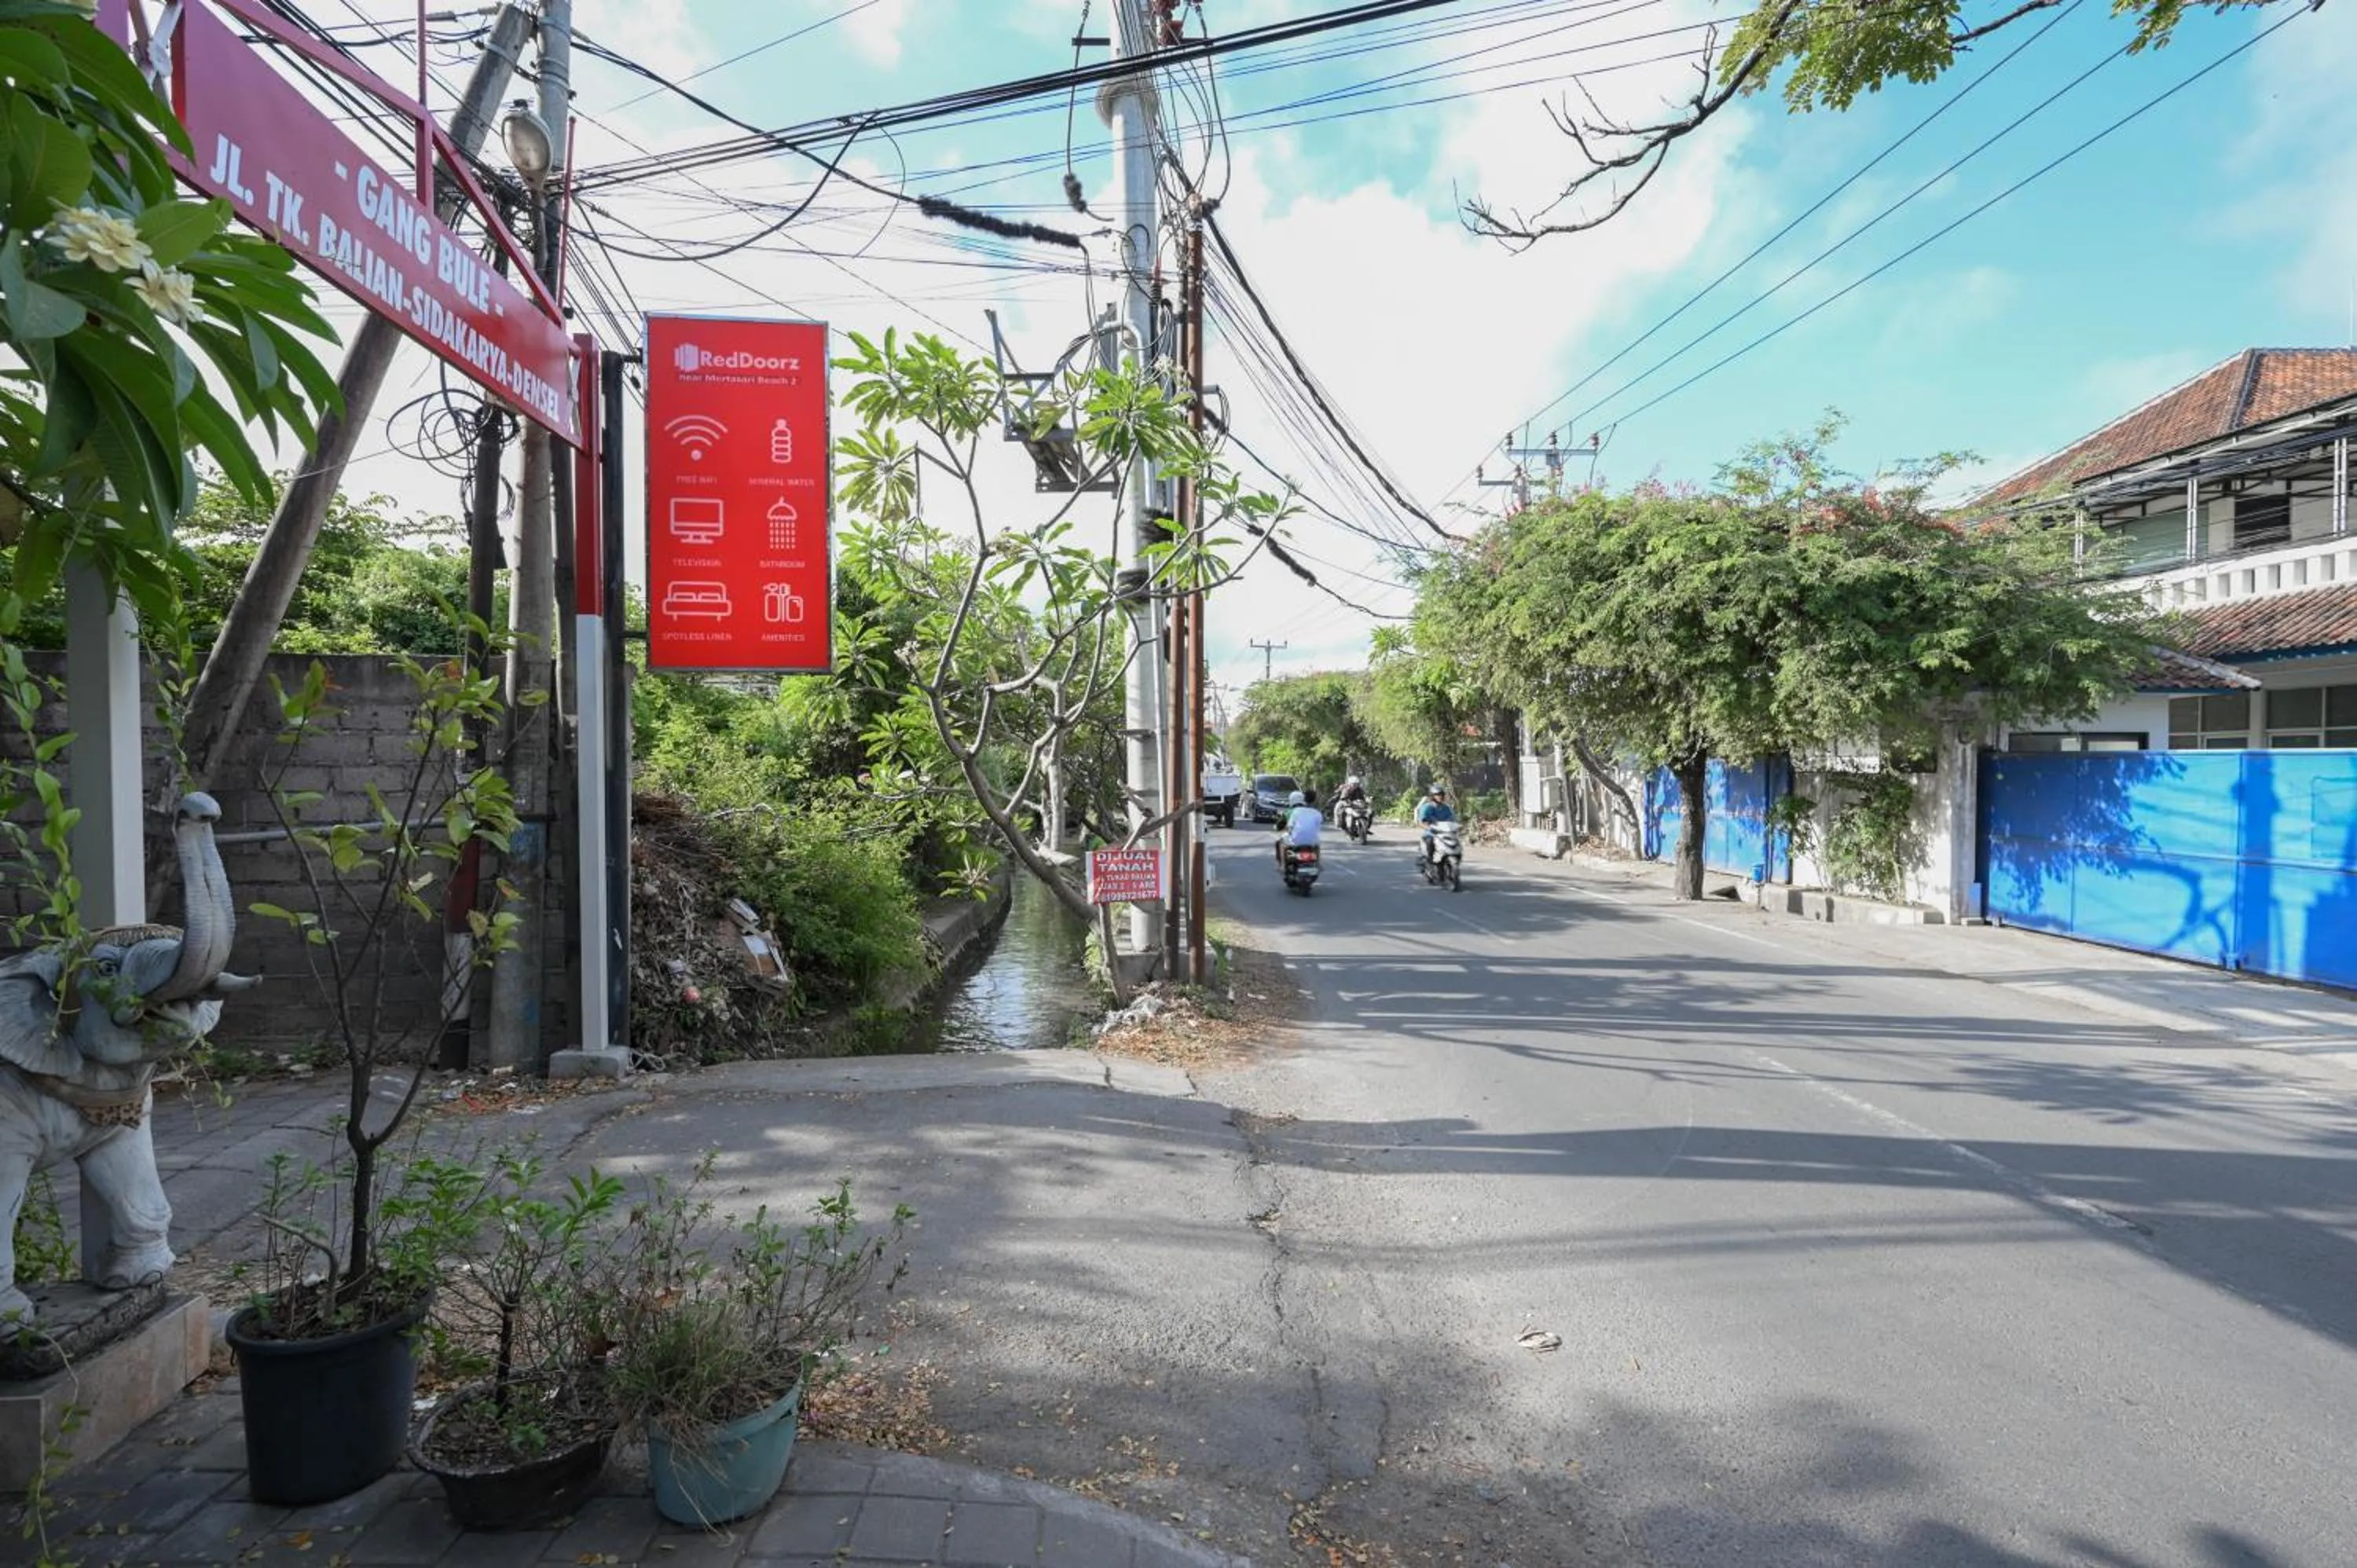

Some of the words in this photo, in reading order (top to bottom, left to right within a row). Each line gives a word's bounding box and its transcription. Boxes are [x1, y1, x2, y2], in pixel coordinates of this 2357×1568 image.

[210, 132, 255, 207] JL.
[265, 170, 309, 247] TK.
[357, 164, 432, 266] GANG
[438, 242, 490, 314] BULE
[700, 350, 800, 371] RedDoorz
[673, 558, 722, 567] TELEVISION
[760, 560, 805, 569] BATHROOM
[662, 632, 706, 641] SPOTLESS
[706, 632, 732, 642] LINEN
[761, 633, 805, 643] AMENITIES
[1096, 852, 1156, 862] DIJUAL
[1098, 863, 1154, 872] TANAH
